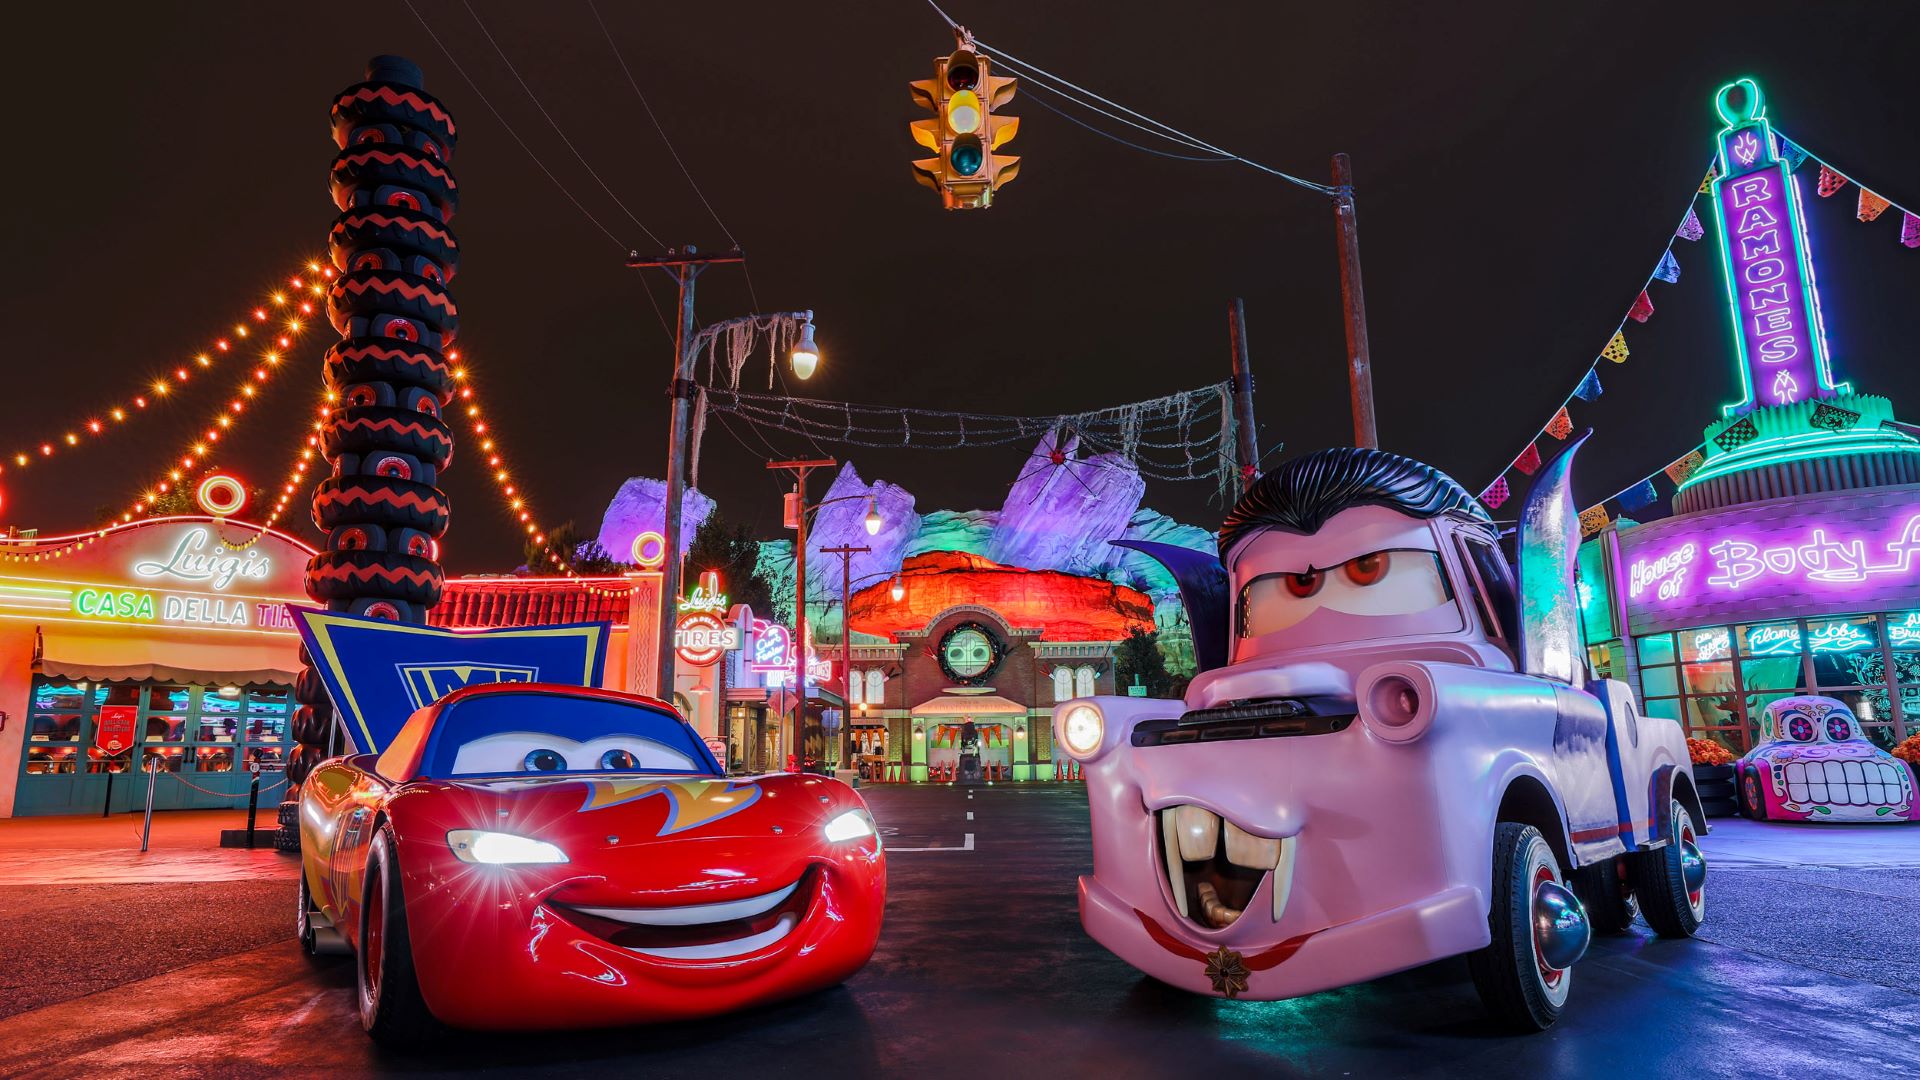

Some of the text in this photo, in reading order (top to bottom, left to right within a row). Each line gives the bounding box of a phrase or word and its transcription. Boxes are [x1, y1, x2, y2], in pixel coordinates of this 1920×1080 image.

[1732, 177, 1798, 363] RAMONES
[1629, 543, 1695, 598] House
[1708, 530, 1867, 588] Body
[1657, 567, 1688, 600] of
[77, 588, 153, 619] CASA
[163, 595, 248, 625] DELLA
[675, 630, 734, 647] TIRES
[1749, 623, 1866, 650] Flame Jobs
